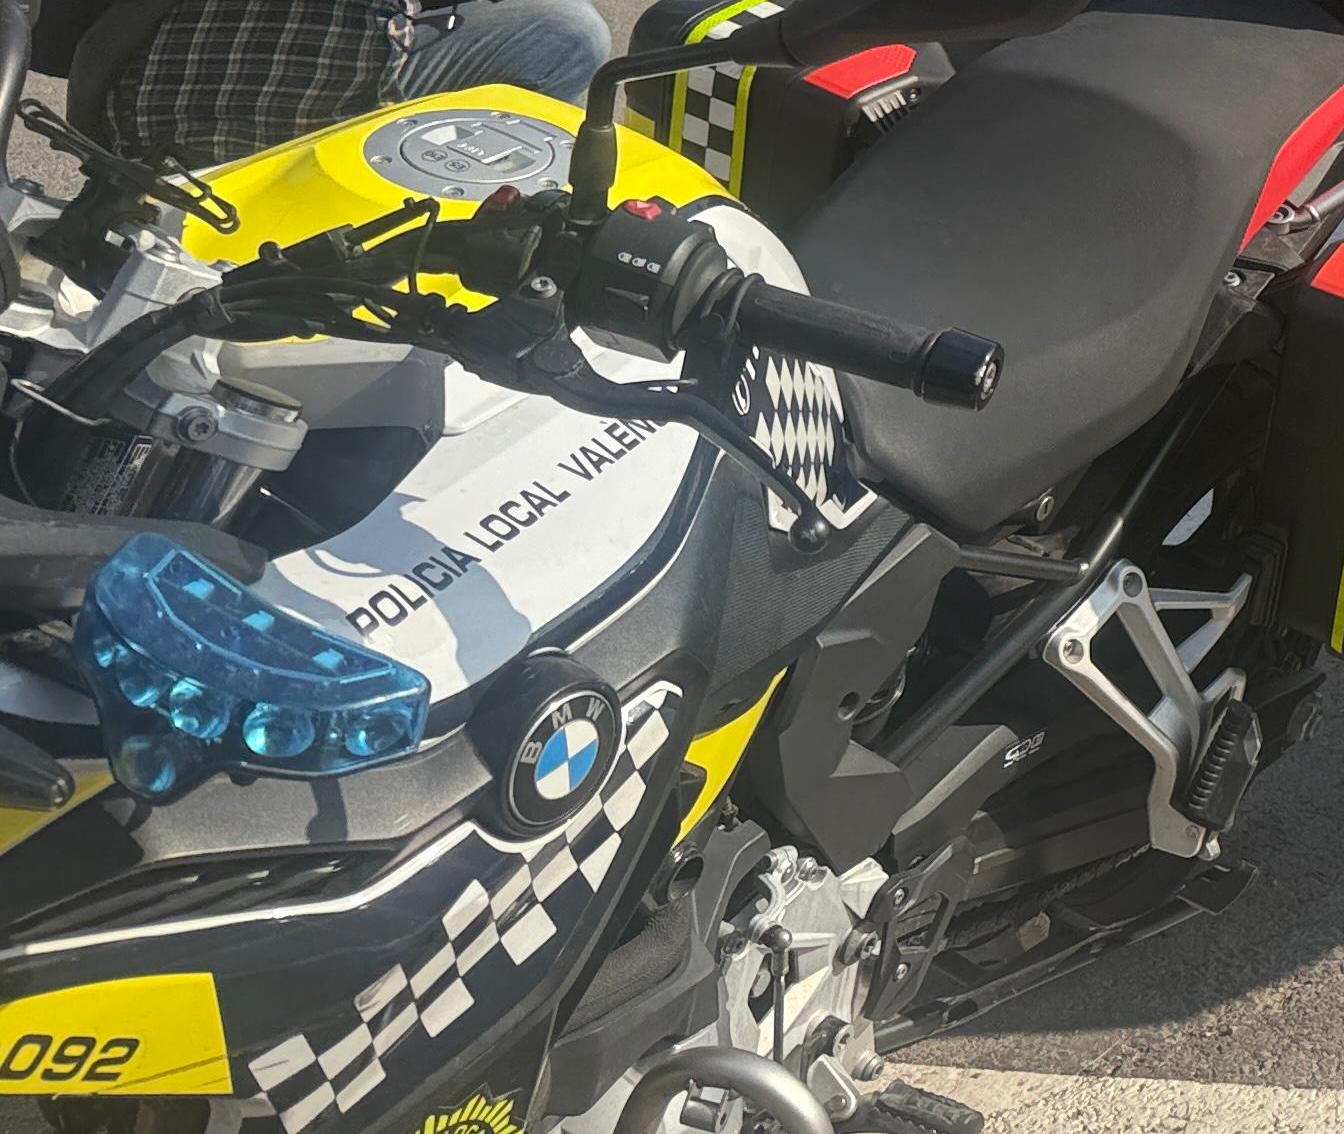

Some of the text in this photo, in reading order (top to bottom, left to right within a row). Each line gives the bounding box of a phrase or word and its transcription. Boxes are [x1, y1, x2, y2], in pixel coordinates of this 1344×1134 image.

[346, 418, 664, 637] POLICIA LOCAL VALÈN
[520, 697, 605, 765] BMW
[0, 1034, 140, 1082] 092
